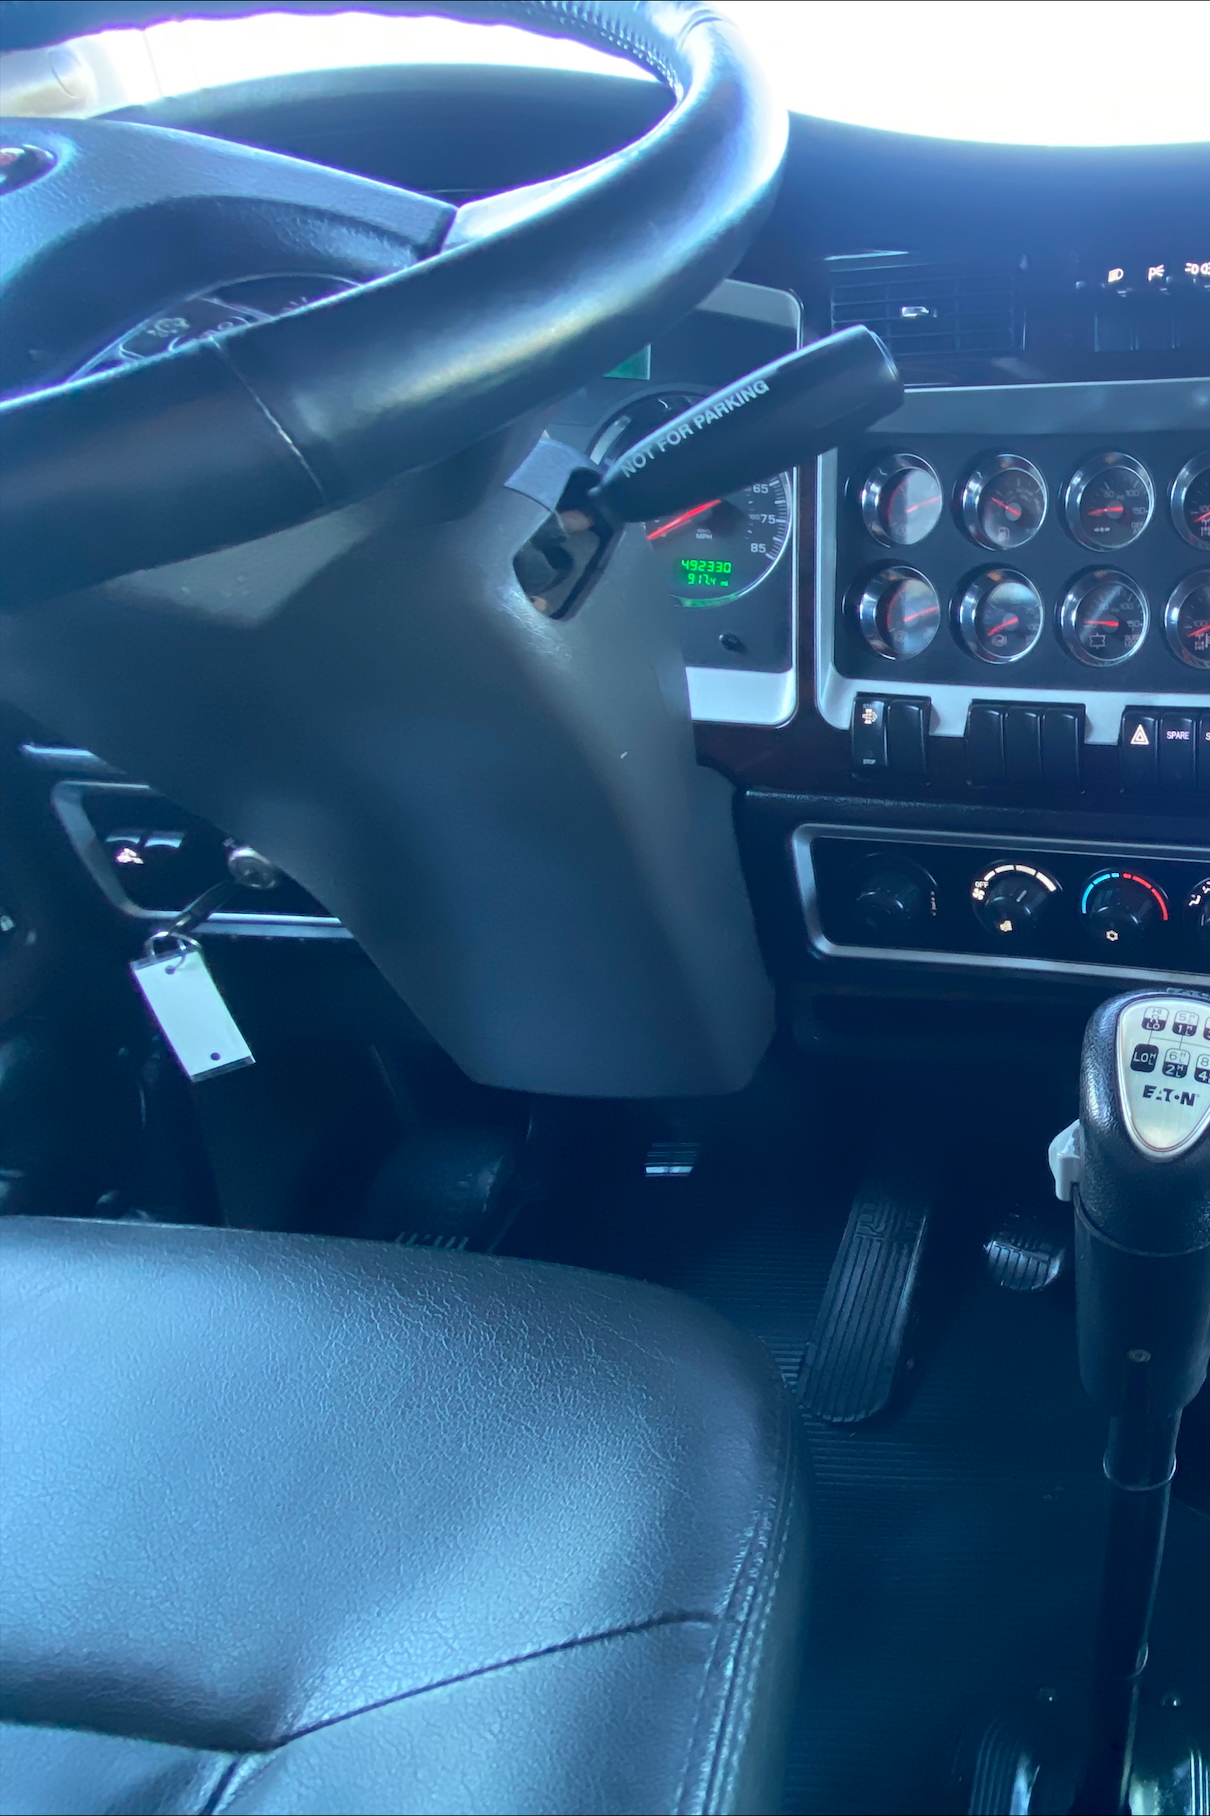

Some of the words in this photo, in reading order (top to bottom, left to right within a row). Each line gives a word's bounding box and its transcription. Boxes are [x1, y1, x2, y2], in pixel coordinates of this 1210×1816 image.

[621, 445, 655, 478] NOT
[656, 423, 694, 452] FOR
[693, 380, 770, 430] PARKING
[753, 484, 769, 494] 65
[760, 514, 776, 524] 75
[751, 543, 766, 553] 85
[681, 560, 732, 573] 492330
[1167, 731, 1190, 740] SPARE
[1179, 1013, 1186, 1021] 5
[1146, 1022, 1160, 1030] LO
[1169, 1051, 1177, 1060] 6
[1200, 1057, 1209, 1067] 8
[1165, 1065, 1174, 1075] 2
[1198, 1071, 1207, 1081] 4
